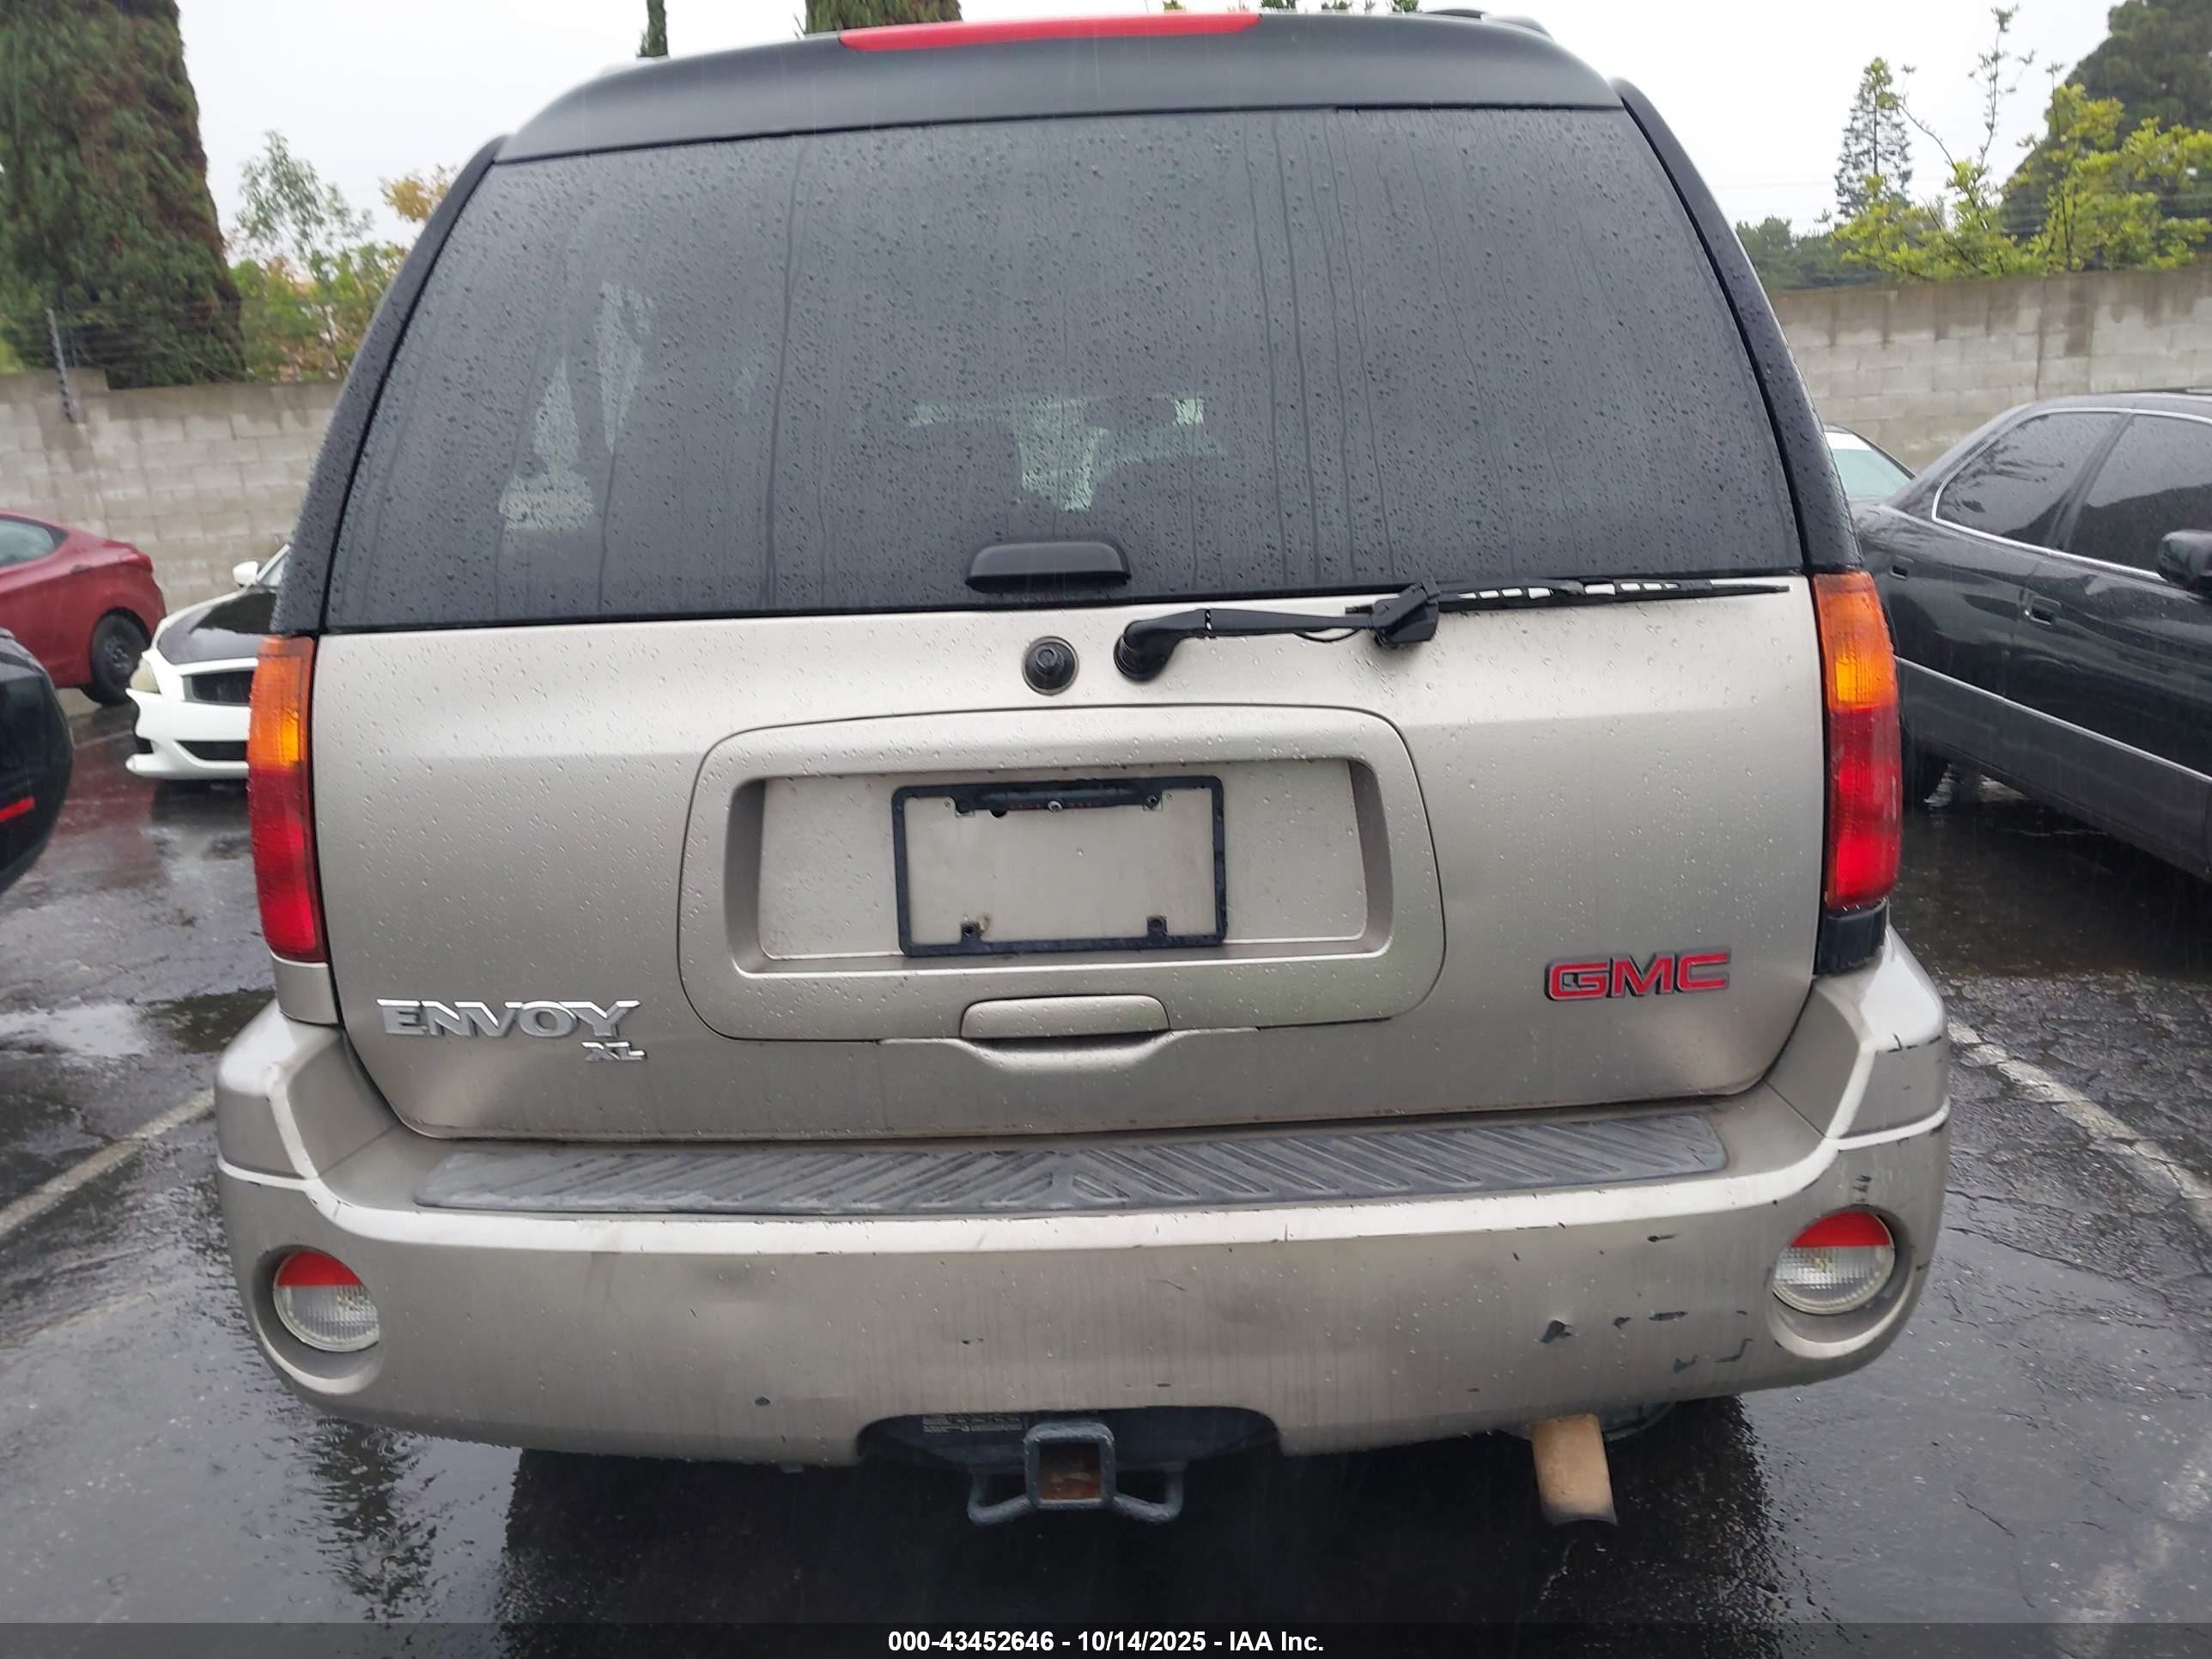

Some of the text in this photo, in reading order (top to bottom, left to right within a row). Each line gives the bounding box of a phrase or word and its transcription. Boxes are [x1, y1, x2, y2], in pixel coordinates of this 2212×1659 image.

[1545, 948, 1729, 1001] GMC
[376, 999, 641, 1037] ENVOY
[581, 1041, 647, 1061] XL
